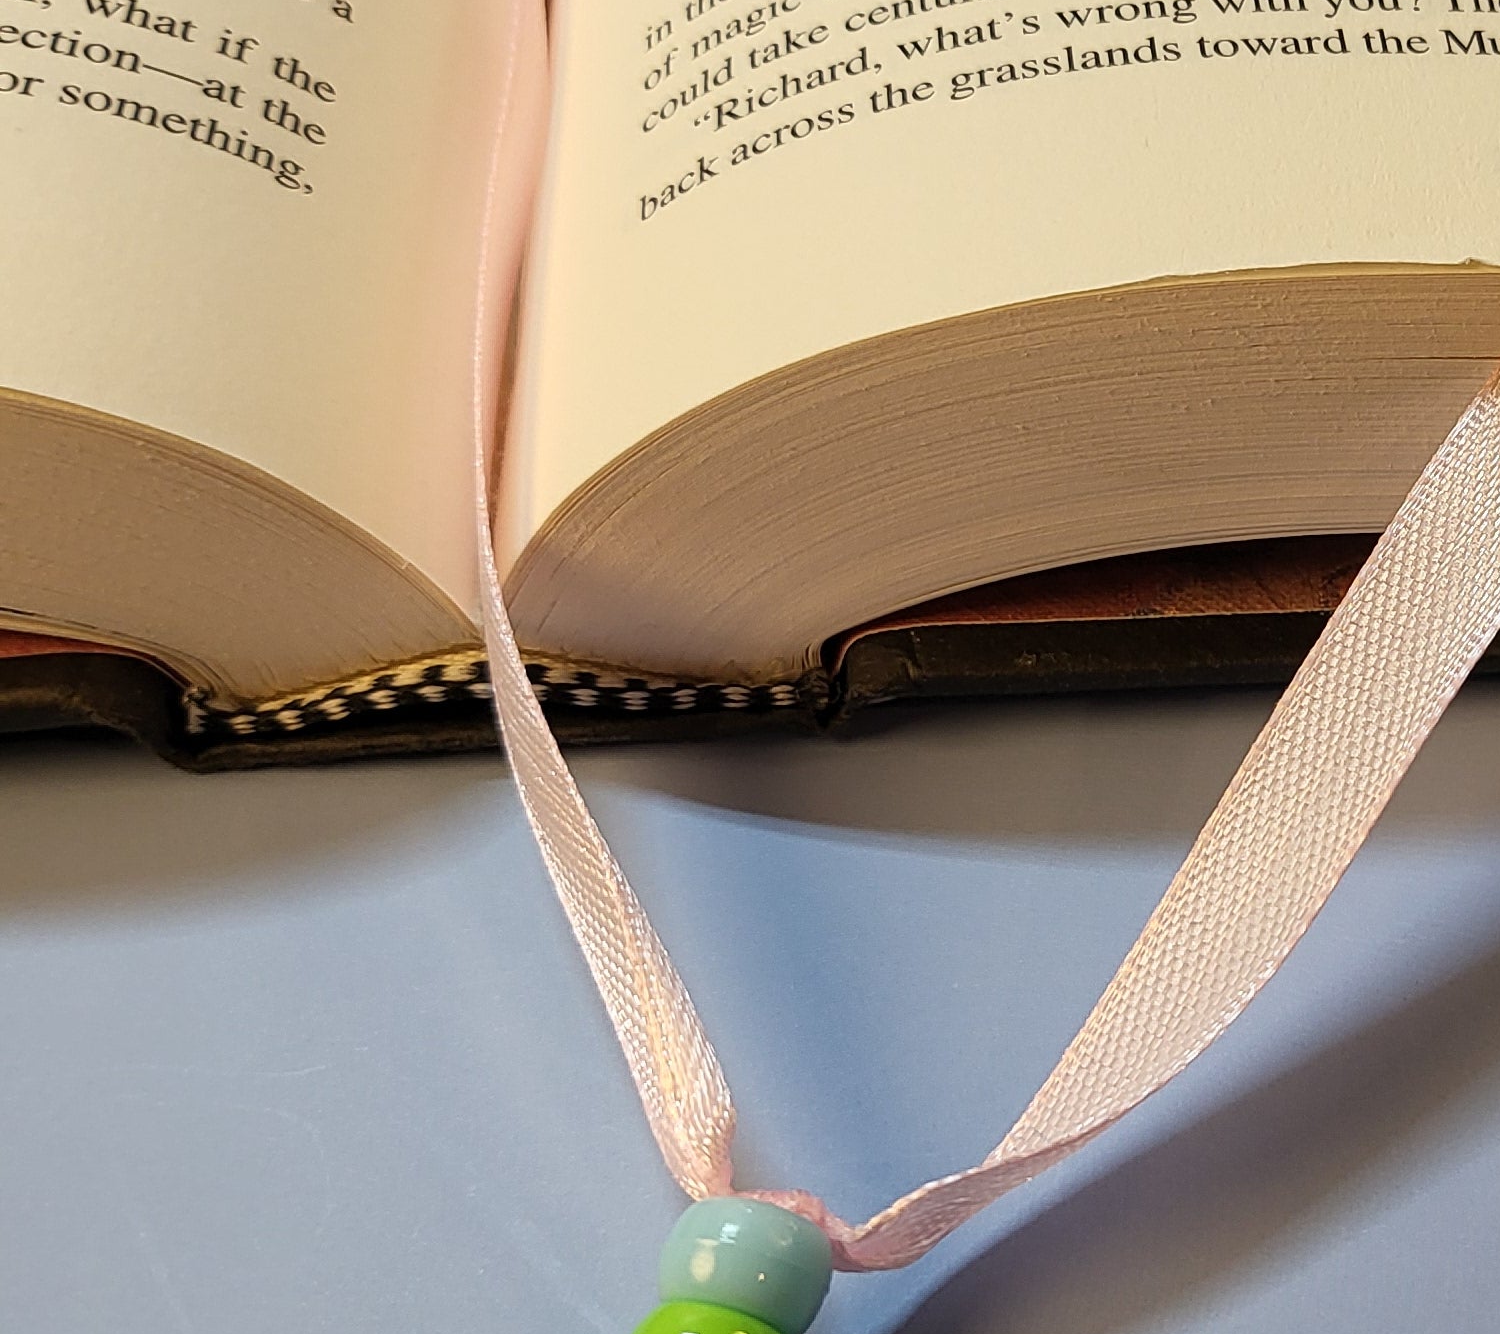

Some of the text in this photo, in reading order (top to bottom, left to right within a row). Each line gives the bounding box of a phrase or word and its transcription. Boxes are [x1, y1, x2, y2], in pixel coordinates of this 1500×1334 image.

[217, 29, 260, 64] if
[273, 56, 337, 103] the
[643, 49, 680, 92] of
[644, 19, 673, 51] in
[642, 57, 734, 133] could
[748, 24, 830, 70] take
[58, 83, 313, 194] something,
[262, 98, 327, 145] the
[639, 157, 719, 221] back
[731, 101, 856, 167] across
[870, 83, 936, 114] the
[949, 37, 1182, 101] grasslands
[1197, 29, 1351, 58] toward
[1361, 29, 1431, 55] the
